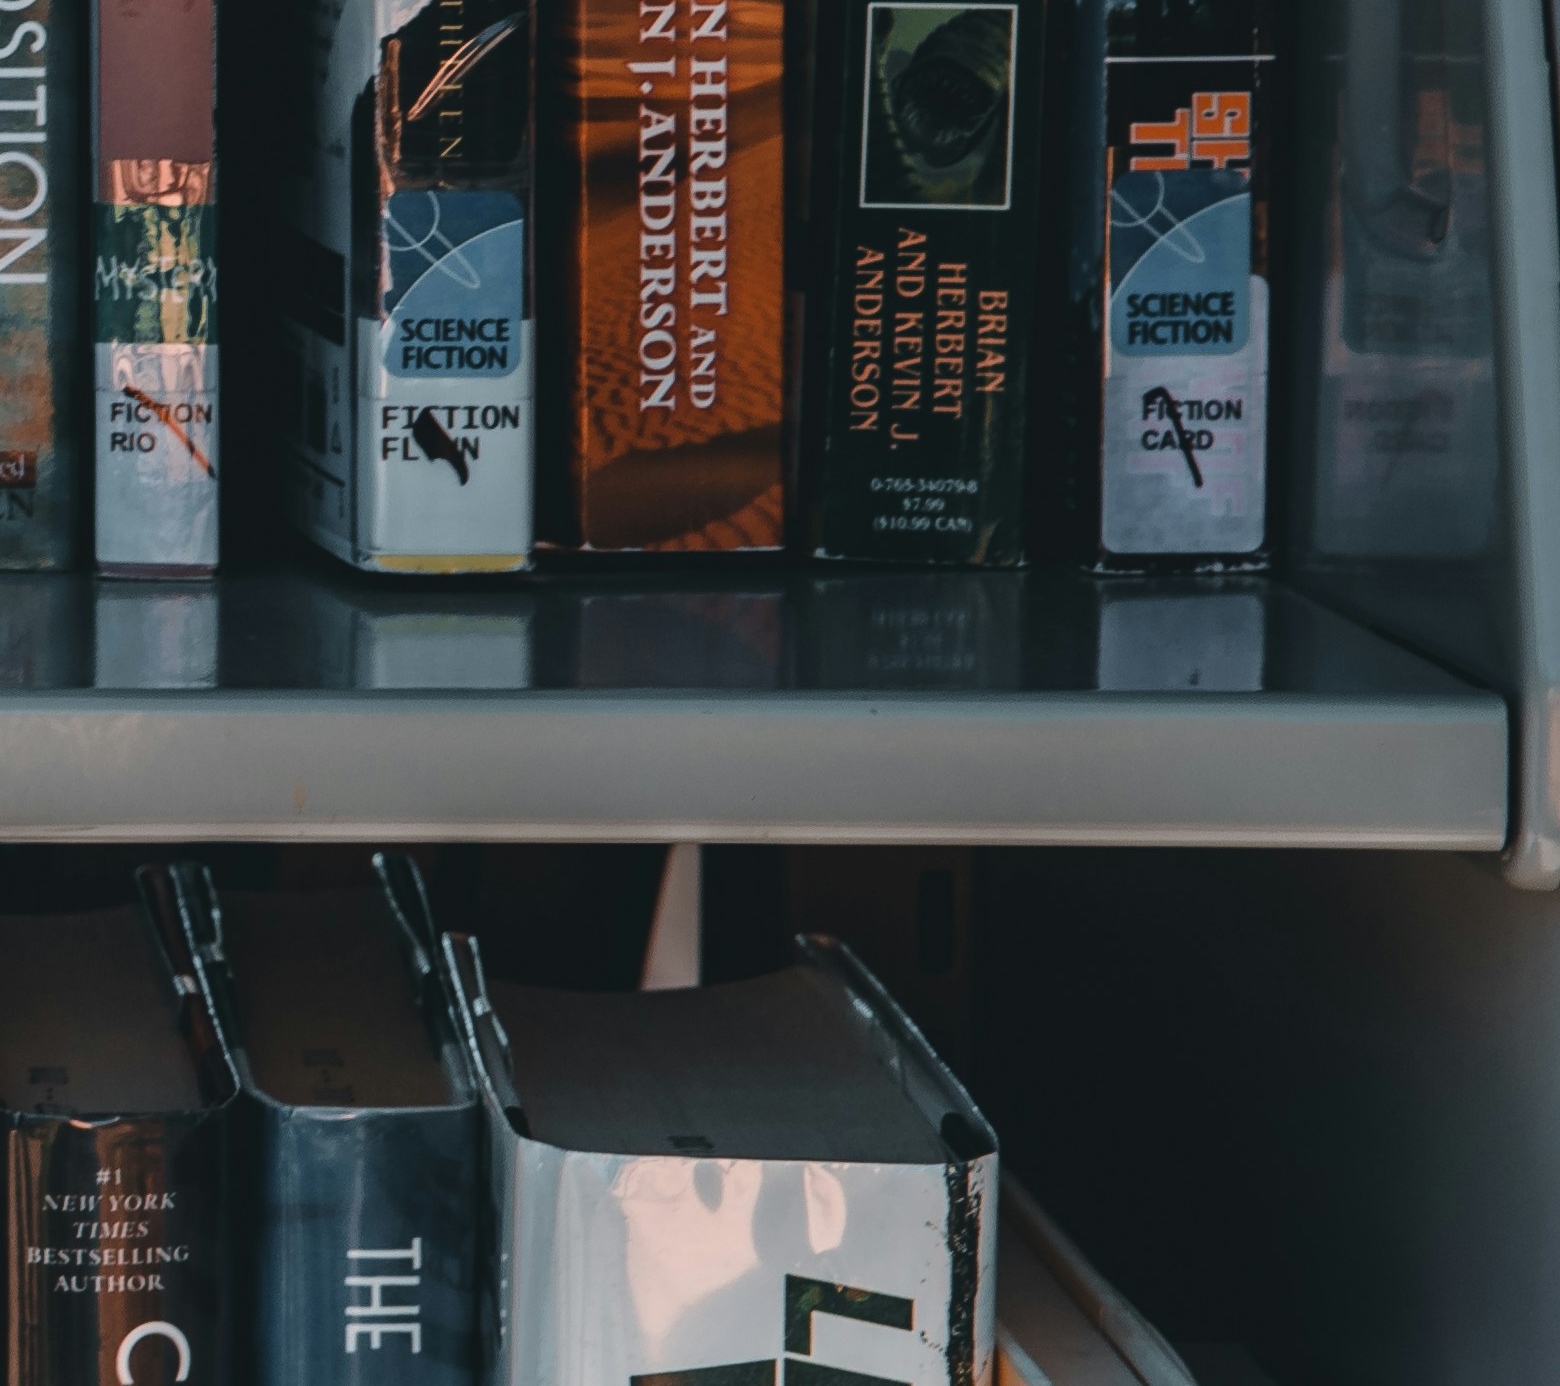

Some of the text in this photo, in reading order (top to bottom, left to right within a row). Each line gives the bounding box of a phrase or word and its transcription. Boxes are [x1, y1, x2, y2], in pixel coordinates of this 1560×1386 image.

[399, 318, 511, 344] SCIENCE
[399, 346, 509, 371] FICTION
[345, 1236, 421, 1355] THE
